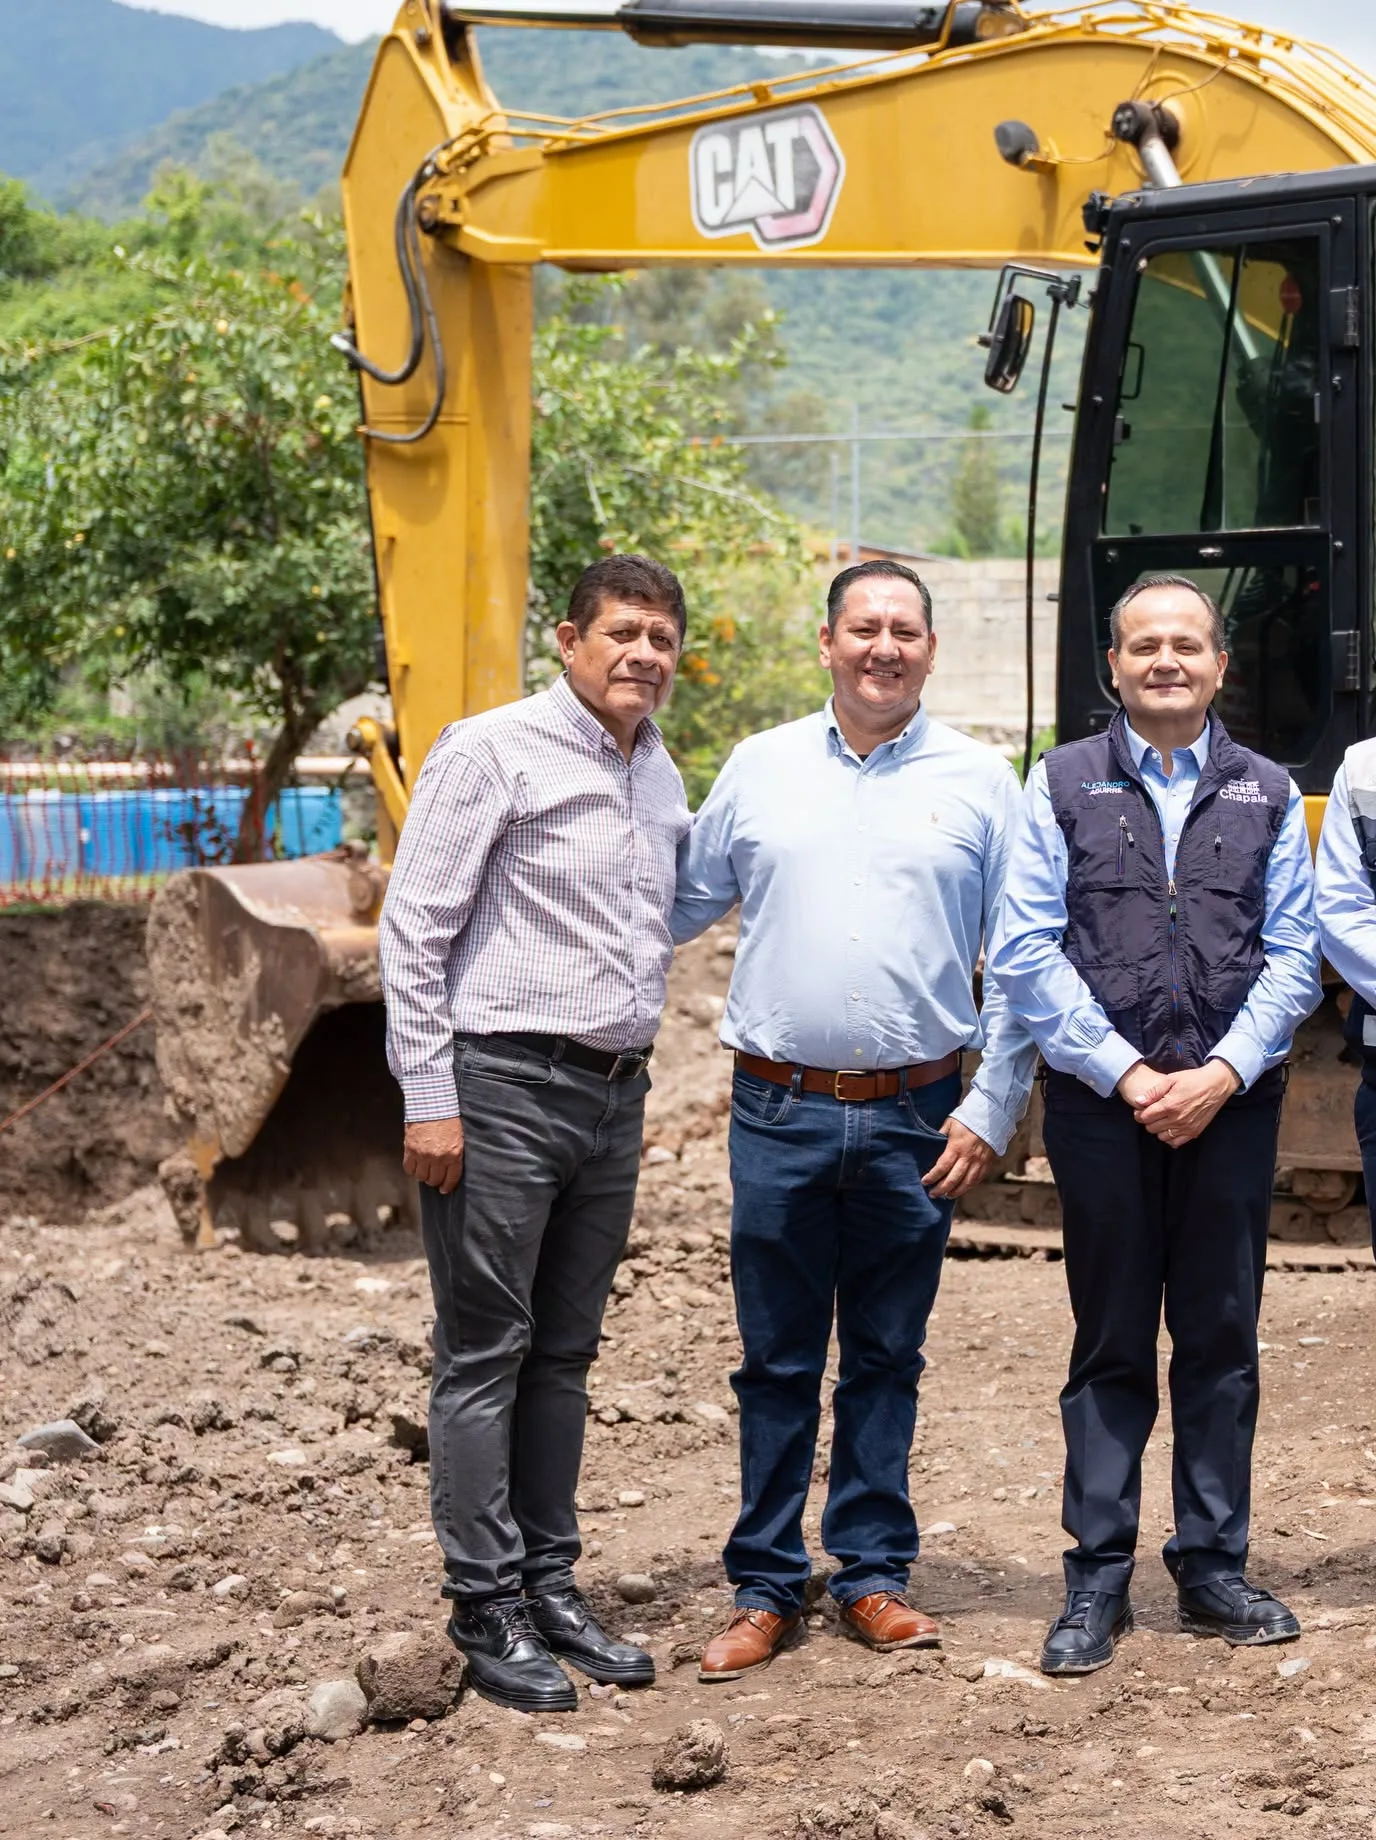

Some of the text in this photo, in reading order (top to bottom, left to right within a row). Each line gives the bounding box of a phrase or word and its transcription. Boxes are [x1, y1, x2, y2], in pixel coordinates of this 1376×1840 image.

[697, 117, 800, 227] CAT
[1080, 781, 1130, 789] ALEJANDRO
[1219, 788, 1269, 804] Chapala
